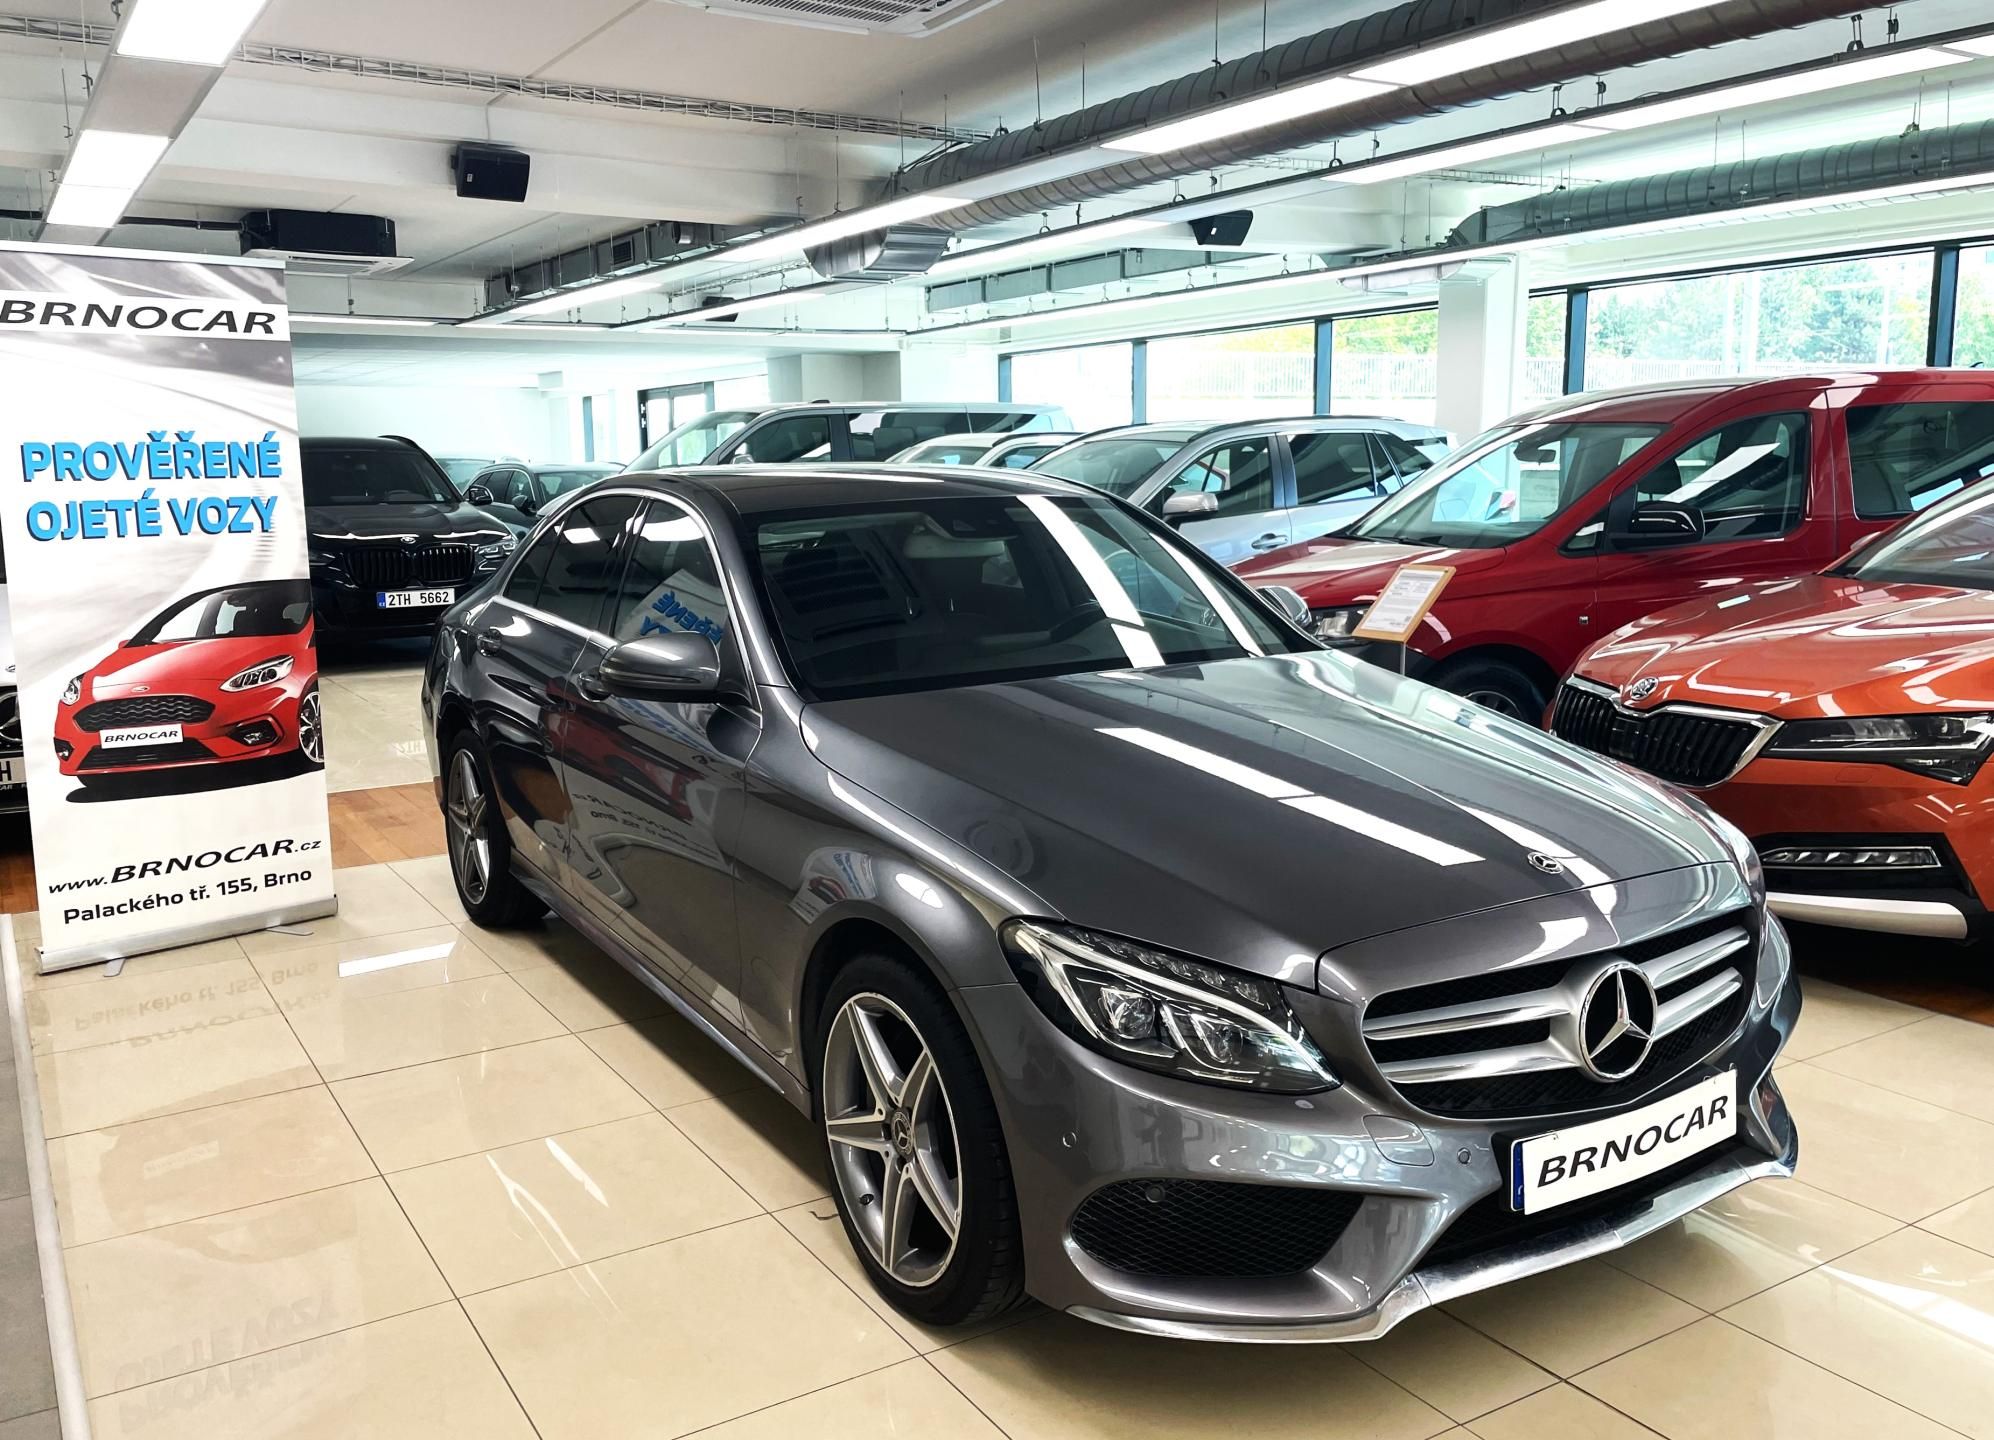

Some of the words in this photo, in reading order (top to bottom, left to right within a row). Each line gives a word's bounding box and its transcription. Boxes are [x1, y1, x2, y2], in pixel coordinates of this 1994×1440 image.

[0, 299, 276, 335] BRNOCAR
[20, 430, 283, 482] PROVĚŘENÉ
[26, 487, 163, 541] OJETÉ
[167, 495, 278, 535] VOZY
[388, 593, 411, 606] 2TH
[420, 591, 449, 604] 5662
[104, 730, 178, 743] BRNOCAR
[48, 838, 322, 894] www.BRNOCAR.cz
[63, 890, 184, 924] Palackého
[189, 885, 210, 902] tř.
[216, 877, 258, 896] 155,
[264, 870, 312, 888] Brno
[1537, 1095, 1729, 1188] BRNOCAR
